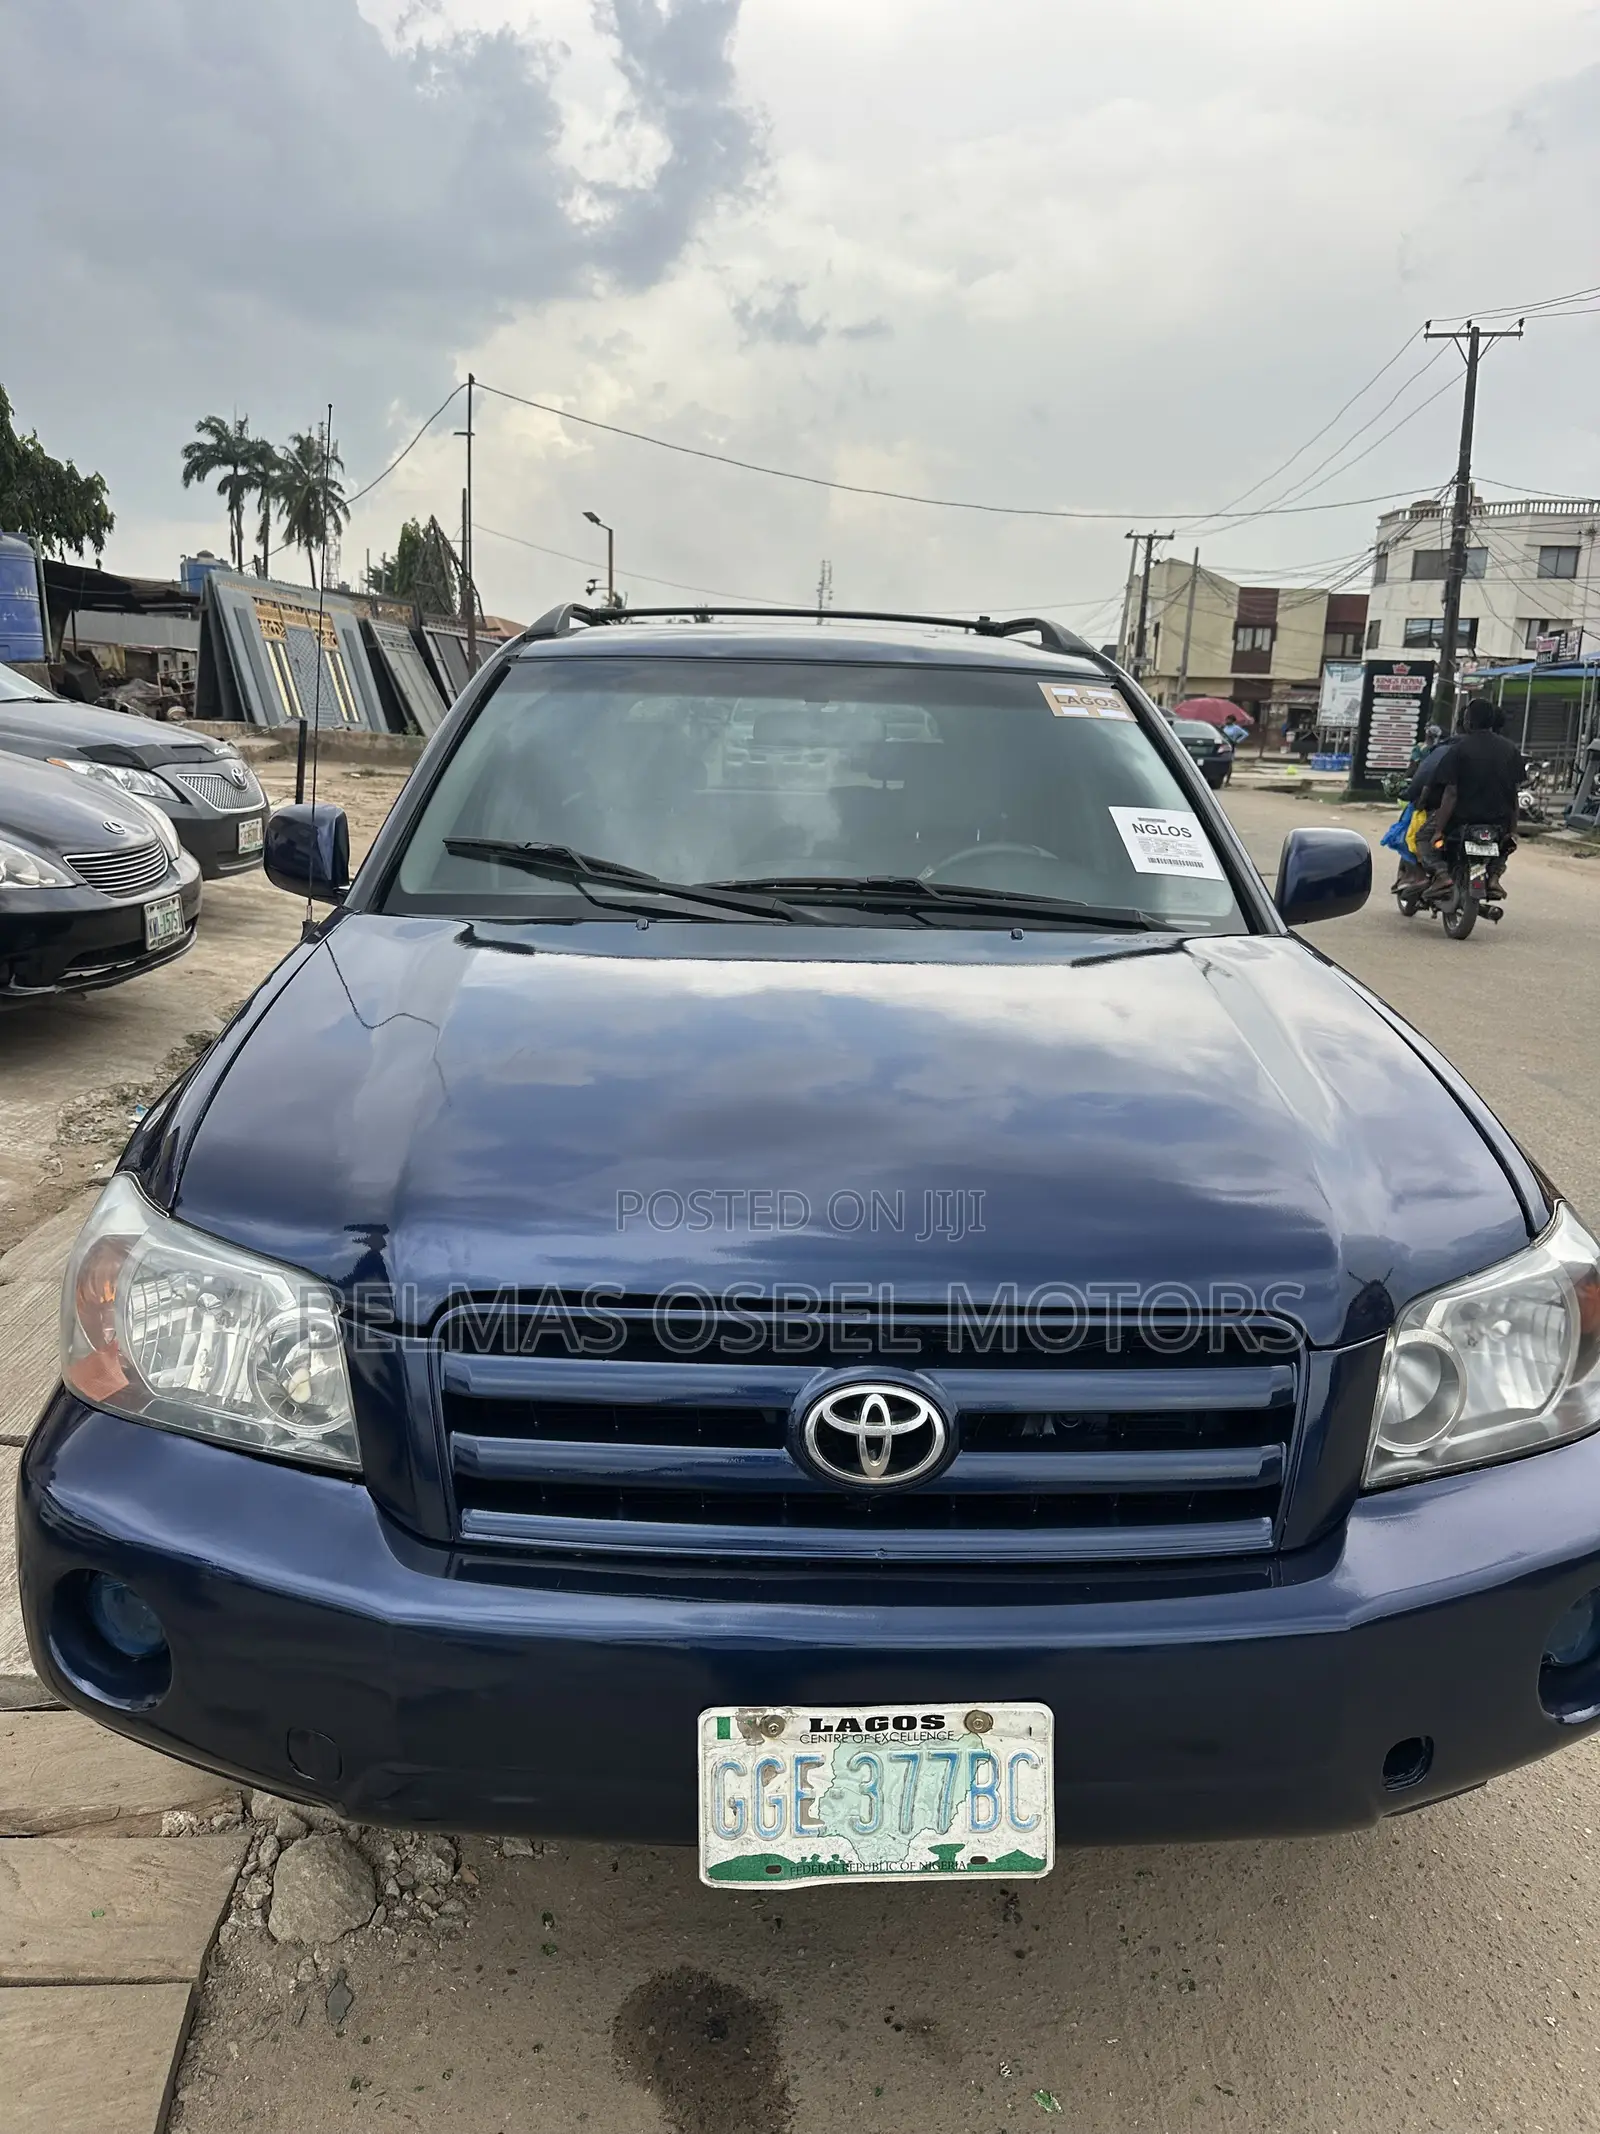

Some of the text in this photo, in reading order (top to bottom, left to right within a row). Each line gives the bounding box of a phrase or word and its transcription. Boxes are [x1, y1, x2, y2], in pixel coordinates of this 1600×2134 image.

[1054, 695, 1121, 708] LAGOS
[1132, 823, 1192, 838] NGLOS
[809, 1715, 946, 1732] LAGOS
[800, 1730, 955, 1744] CENTRE OF EXCELLENCE
[790, 1859, 968, 1876] FEDERAL REPUBLIC OF NIGERIA
